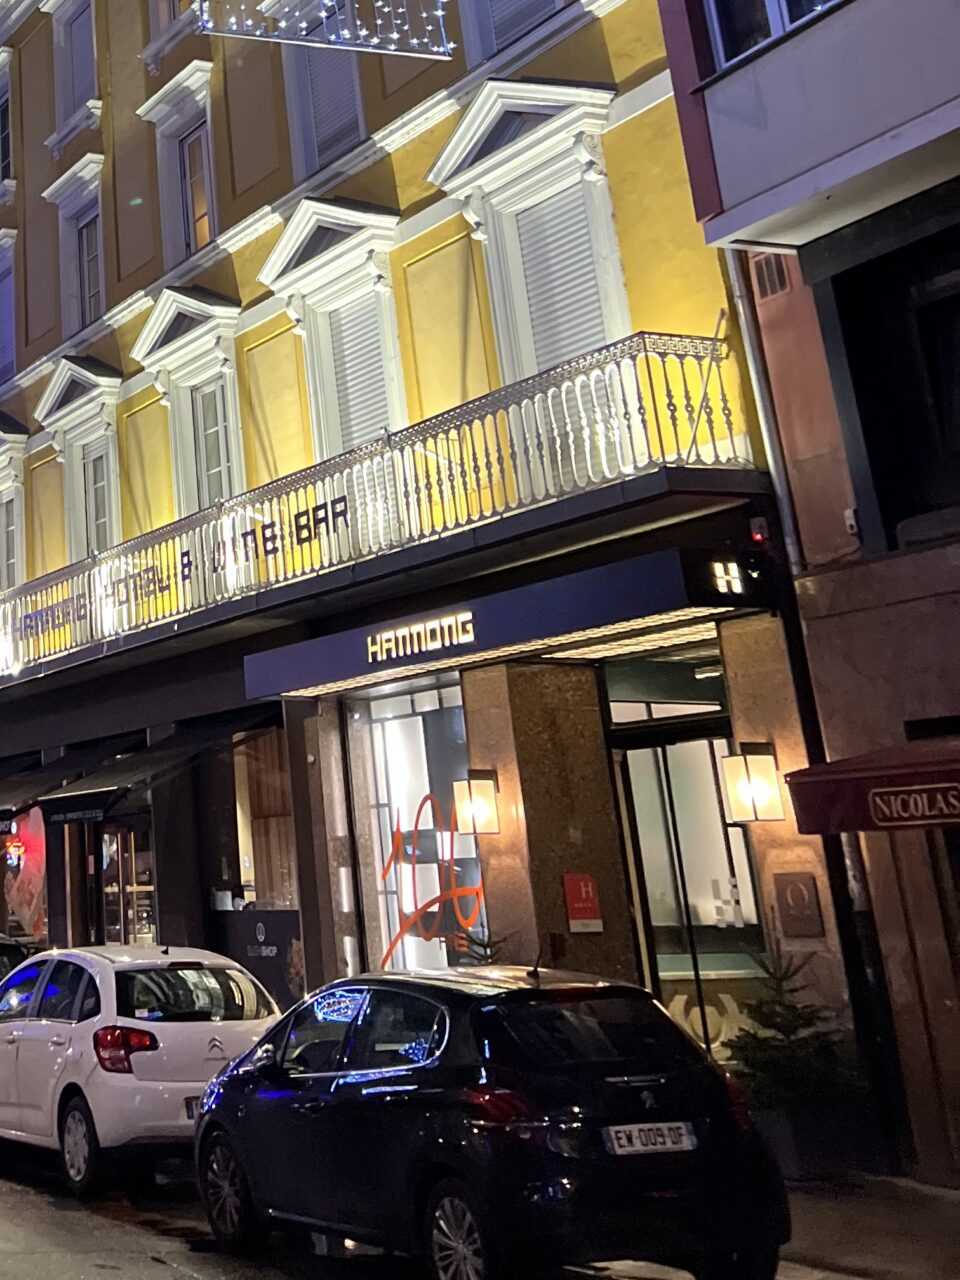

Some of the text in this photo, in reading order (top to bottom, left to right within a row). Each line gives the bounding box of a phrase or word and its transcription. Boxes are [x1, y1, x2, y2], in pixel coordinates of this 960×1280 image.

[293, 494, 350, 546] BAR
[713, 562, 743, 594] H
[873, 790, 960, 818] NICOLAS
[580, 881, 594, 899] H
